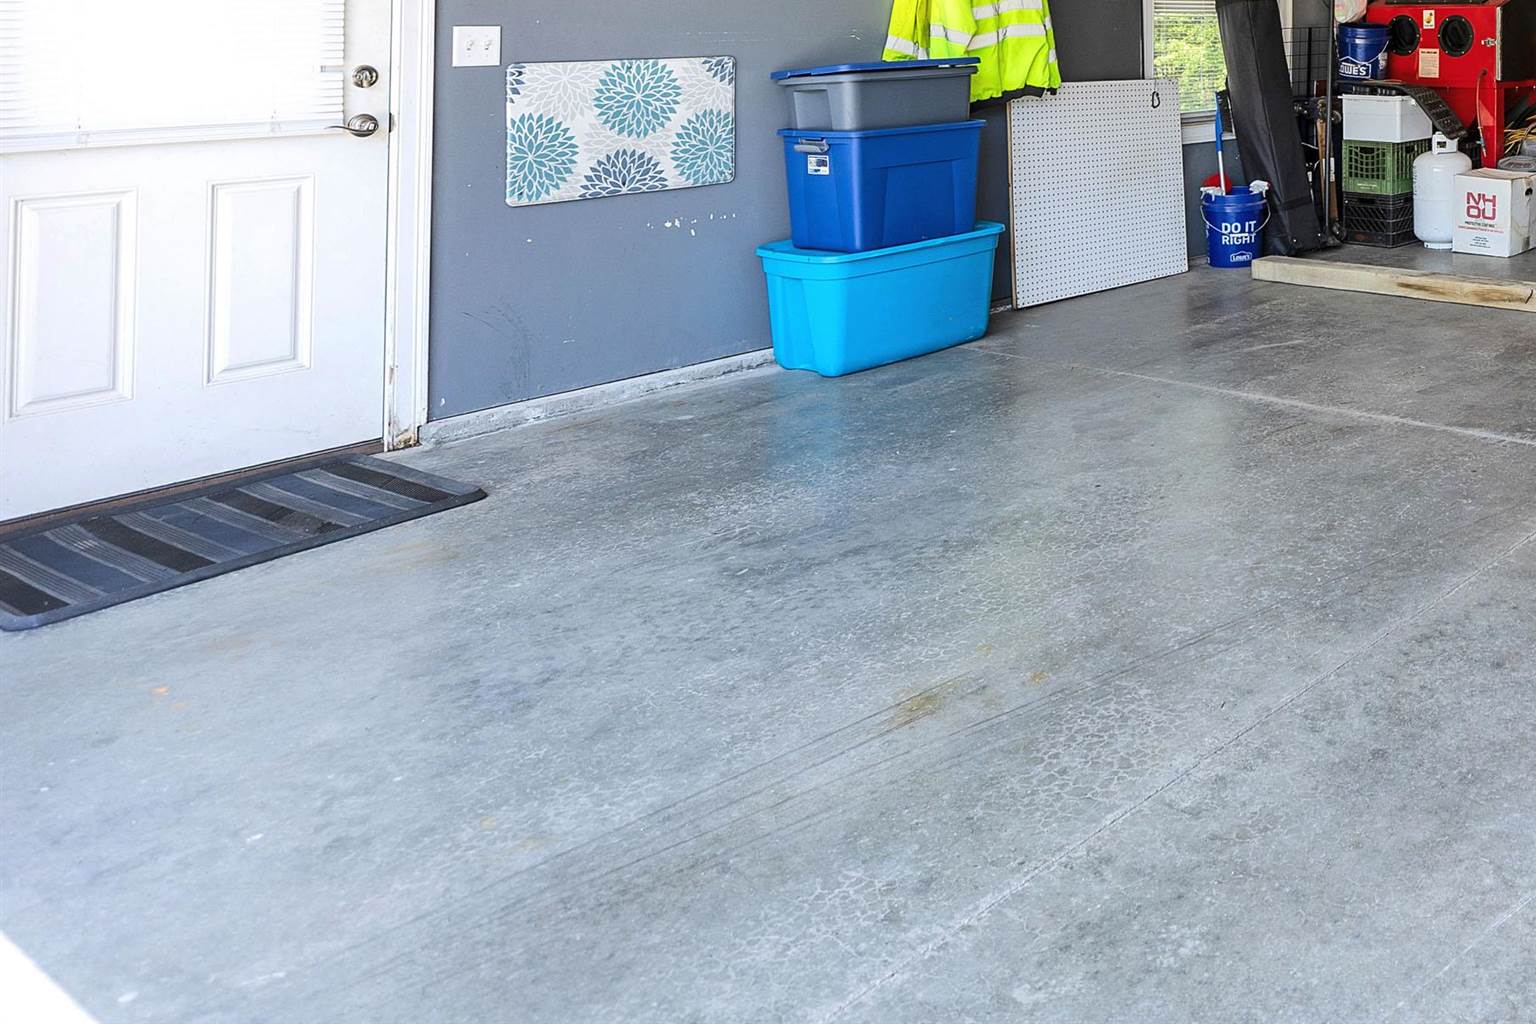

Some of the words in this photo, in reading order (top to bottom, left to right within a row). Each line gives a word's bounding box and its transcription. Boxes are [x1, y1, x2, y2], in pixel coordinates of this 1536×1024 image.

[1340, 64, 1367, 76] OWE'S
[1221, 222, 1241, 233] DO
[1245, 221, 1256, 233] IT
[1221, 233, 1256, 245] RIGHT
